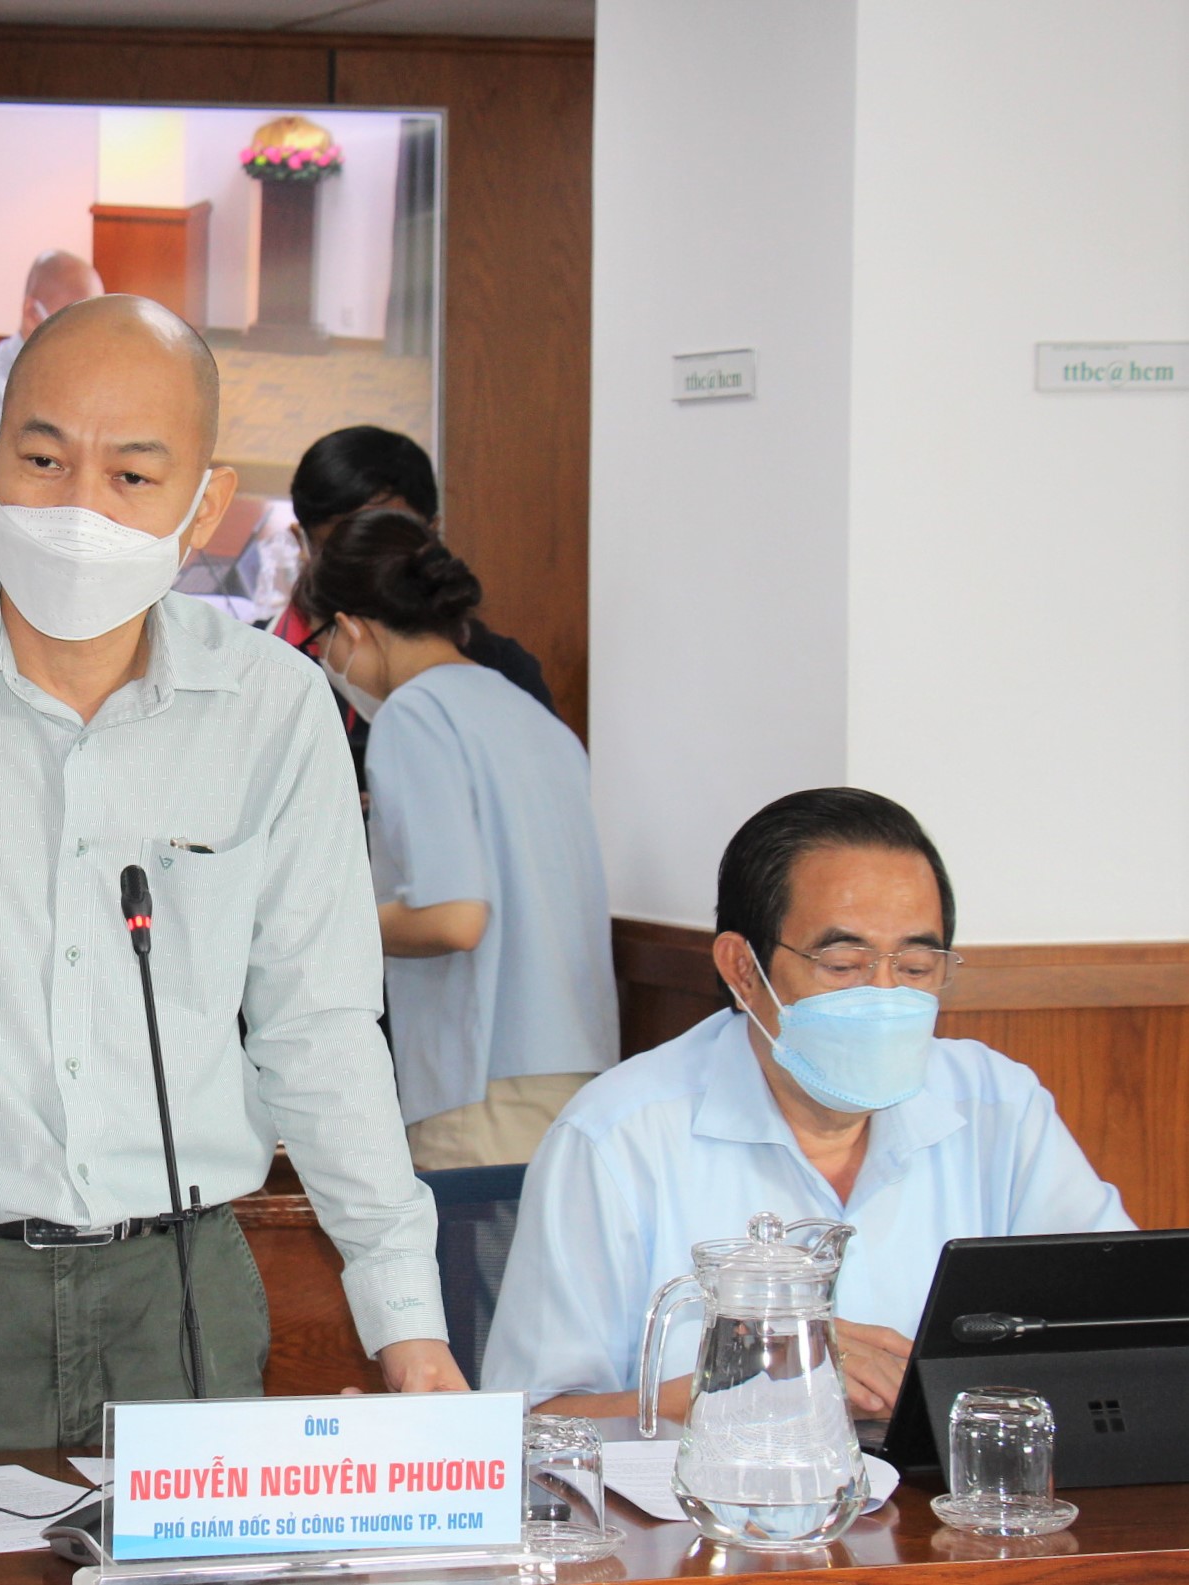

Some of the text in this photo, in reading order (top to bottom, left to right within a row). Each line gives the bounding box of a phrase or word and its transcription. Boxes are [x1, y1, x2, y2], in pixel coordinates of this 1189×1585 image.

[304, 1415, 340, 1436] ÔNG
[130, 1456, 505, 1501] NGUYỄN NGUYÊN PHƯƠNG
[153, 1511, 483, 1539] PHÓ GIÁM ĐỐC SỞ CÔNG THƯƠNG TP. HCM
